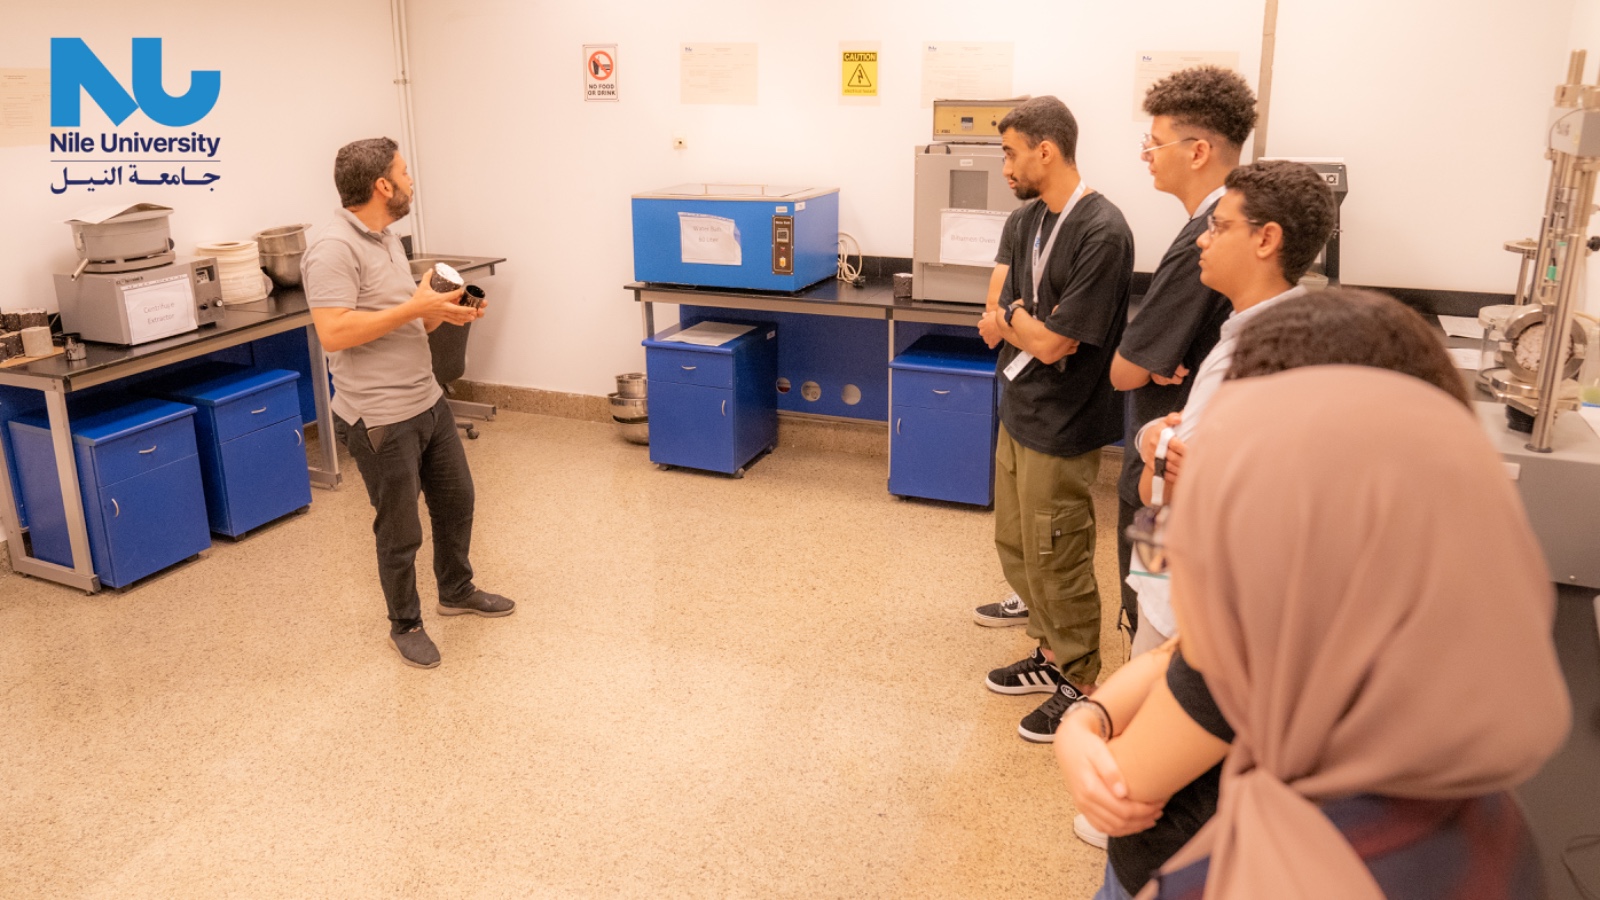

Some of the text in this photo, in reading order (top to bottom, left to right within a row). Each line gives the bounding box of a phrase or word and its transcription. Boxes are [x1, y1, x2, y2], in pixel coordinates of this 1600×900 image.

[844, 53, 877, 61] CAUTION
[979, 236, 996, 244] Oven
[147, 313, 175, 325] Extractor
